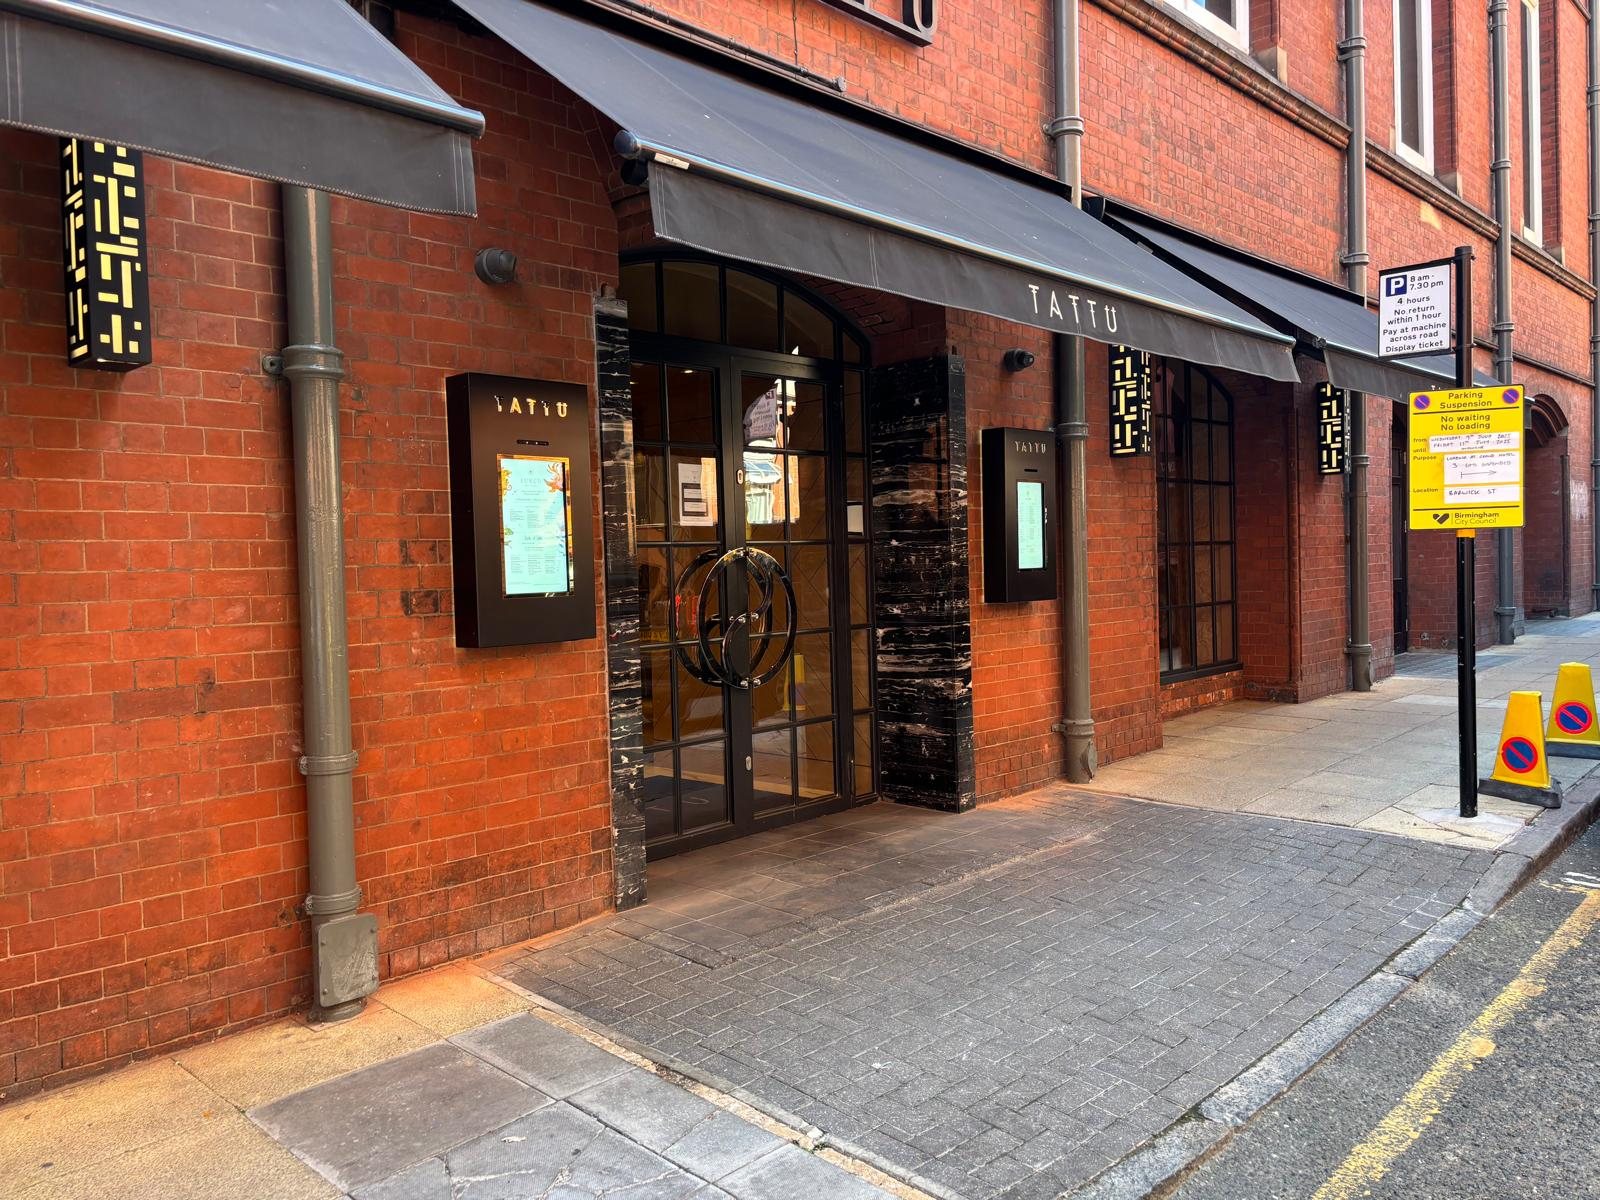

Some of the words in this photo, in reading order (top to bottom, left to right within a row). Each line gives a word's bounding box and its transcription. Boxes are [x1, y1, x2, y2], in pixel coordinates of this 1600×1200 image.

[1417, 274, 1430, 282] am
[1390, 277, 1405, 295] P
[1409, 282, 1429, 291] 7.30
[1430, 280, 1444, 289] pm
[1406, 295, 1431, 304] hours
[1028, 283, 1118, 333] TATTU
[1408, 305, 1435, 314] return
[1387, 315, 1413, 325] within
[1422, 312, 1442, 320] hour
[1382, 328, 1398, 336] Pay
[1411, 321, 1447, 332] machine
[1389, 333, 1417, 342] across
[1419, 331, 1439, 339] road
[1385, 344, 1416, 353] Display
[1418, 340, 1444, 349] ticket
[1448, 391, 1483, 400] Parking
[493, 395, 568, 418] TATTU
[1439, 400, 1492, 409] Suspension
[1440, 415, 1454, 423] No
[1456, 414, 1491, 422] waiting
[1456, 422, 1491, 430] loading
[1014, 440, 1047, 453] TATTU
[1454, 511, 1499, 519] Birmingham
[1454, 518, 1468, 526] City
